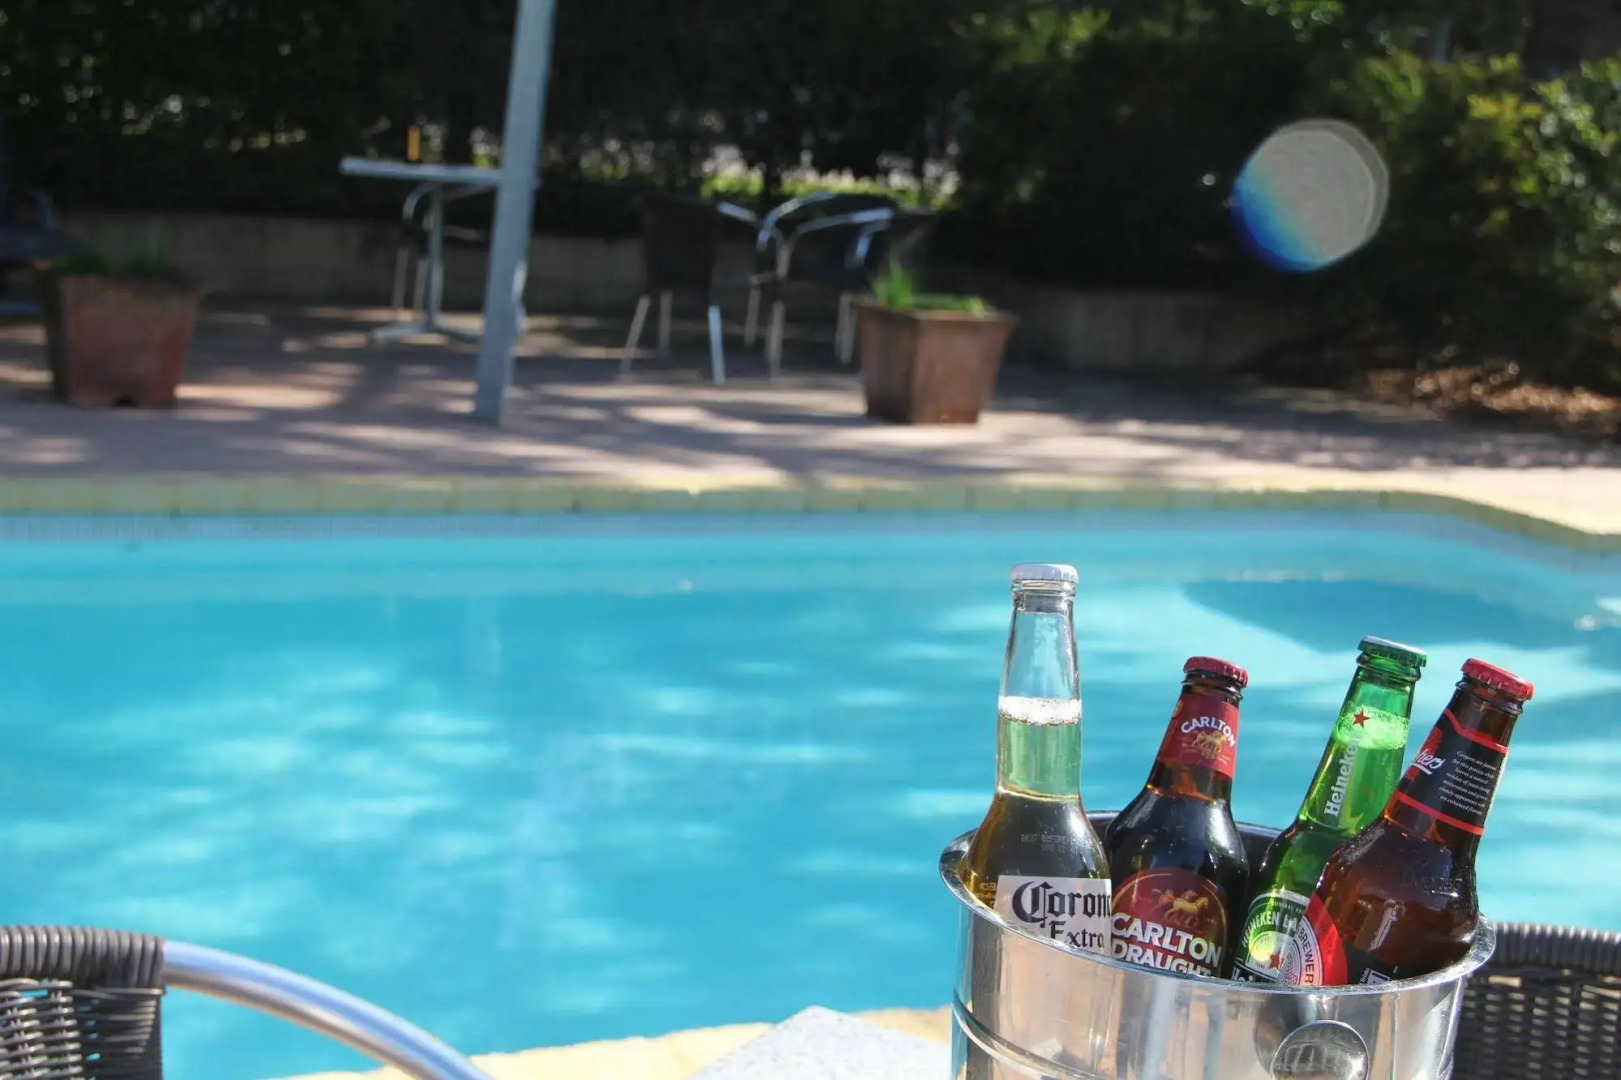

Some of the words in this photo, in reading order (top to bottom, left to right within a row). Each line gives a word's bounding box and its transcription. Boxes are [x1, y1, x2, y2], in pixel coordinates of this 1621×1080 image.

[1181, 716, 1236, 747] CARLTON
[1324, 737, 1361, 817] Heineken
[1049, 920, 1105, 948] Extra
[1111, 912, 1222, 967] CARLTON
